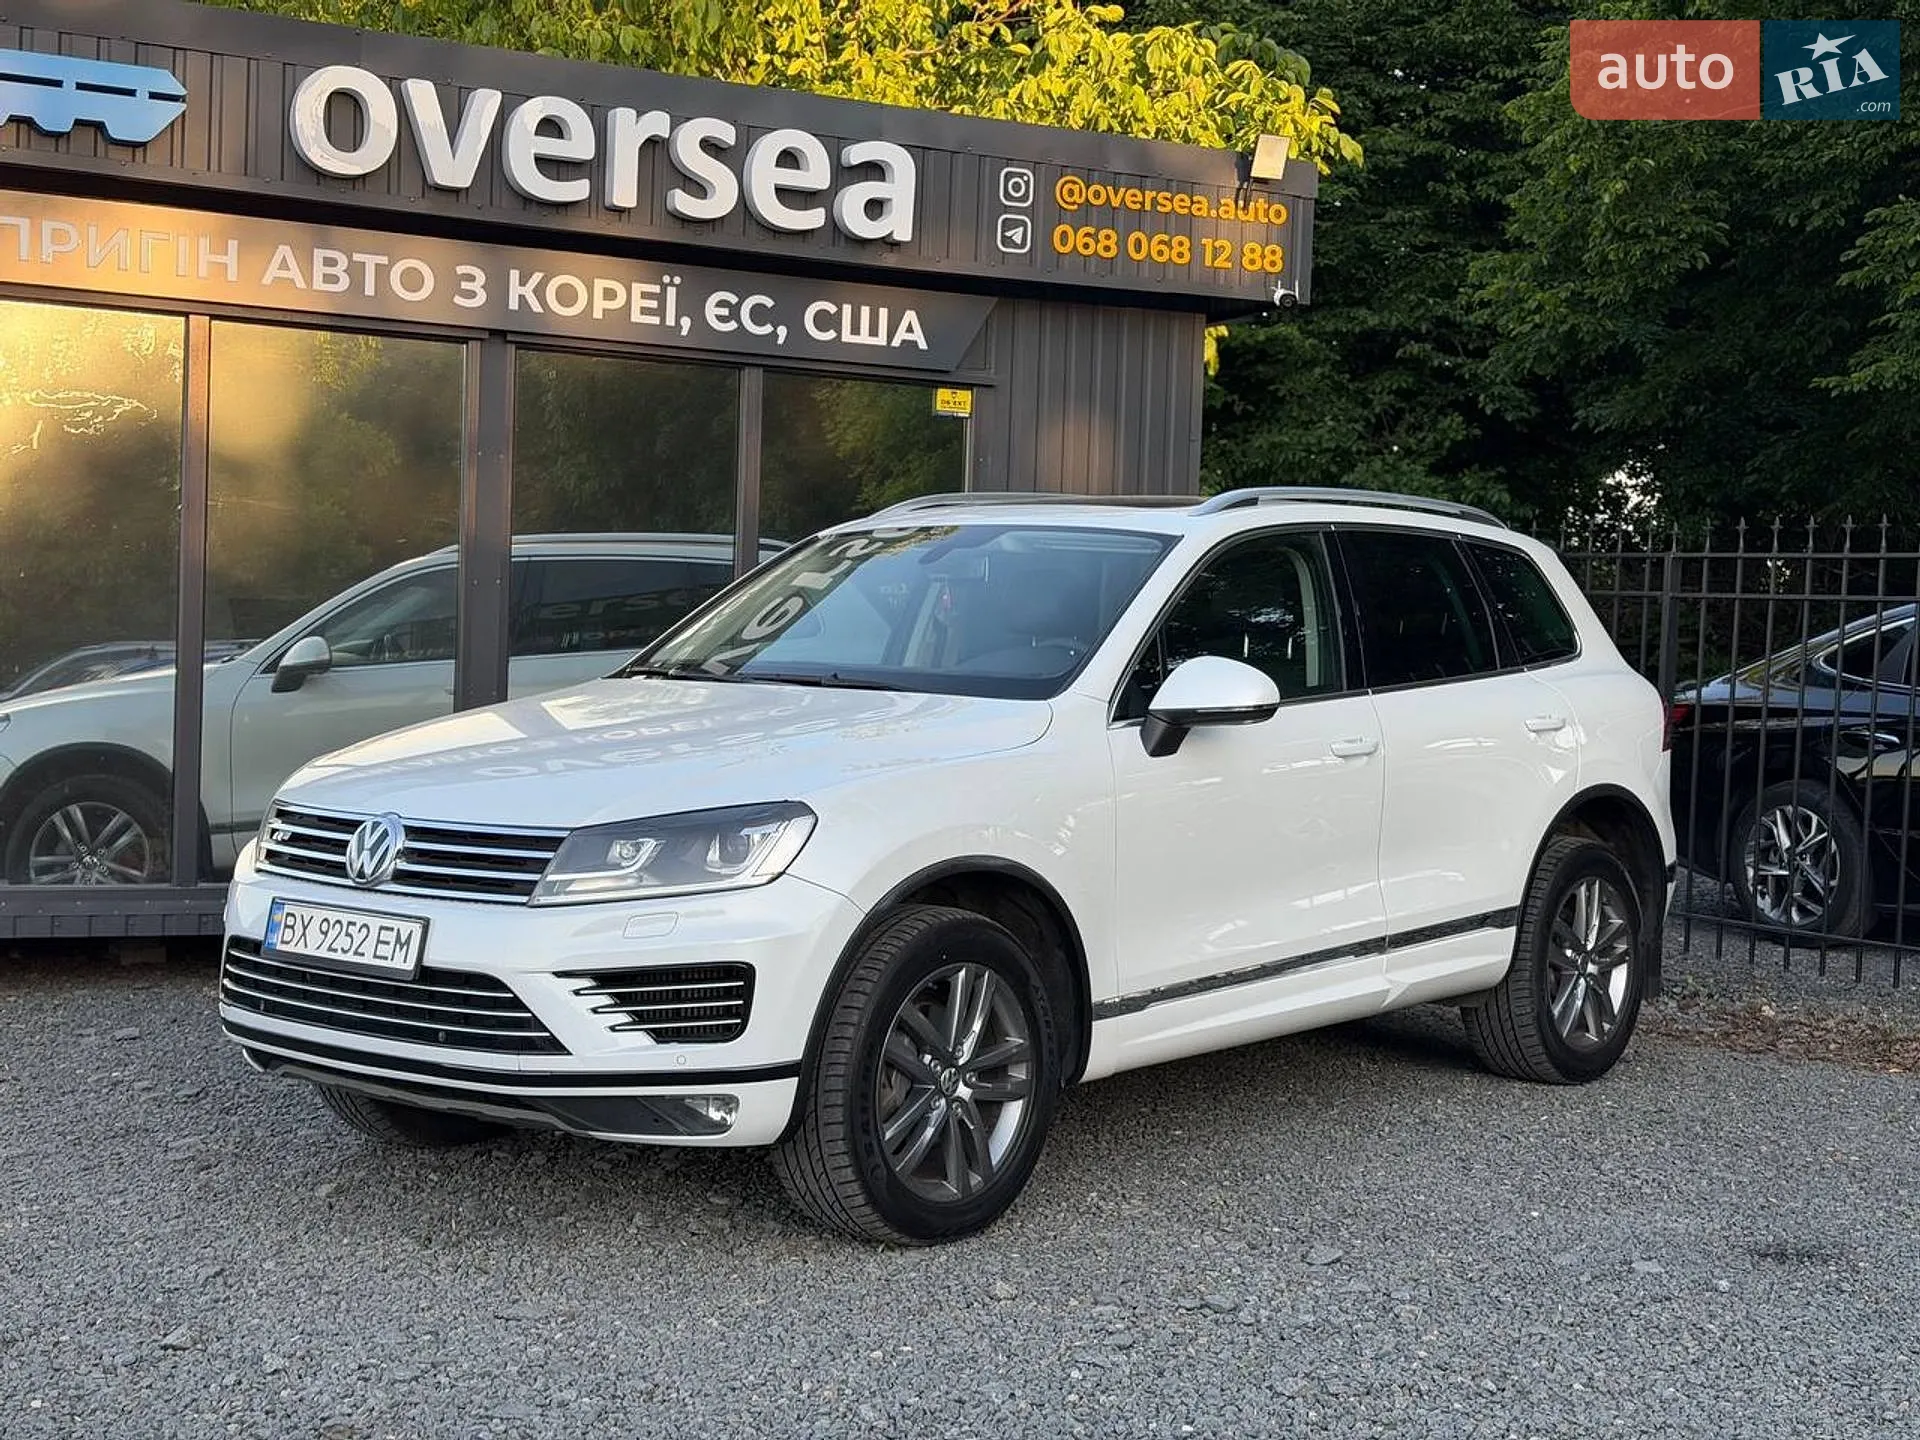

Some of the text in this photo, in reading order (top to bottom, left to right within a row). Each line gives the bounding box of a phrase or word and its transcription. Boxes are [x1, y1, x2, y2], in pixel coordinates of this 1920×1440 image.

[290, 64, 916, 243] oversea
[1055, 175, 1287, 225] @oversea.auto
[1053, 223, 1284, 273] 068 068 12 88
[261, 244, 435, 302] АВТО
[507, 269, 691, 336] КОРЕЇ,
[704, 290, 788, 345] ЄС,
[803, 300, 929, 350] США
[280, 911, 414, 964] BX 9252 EM
